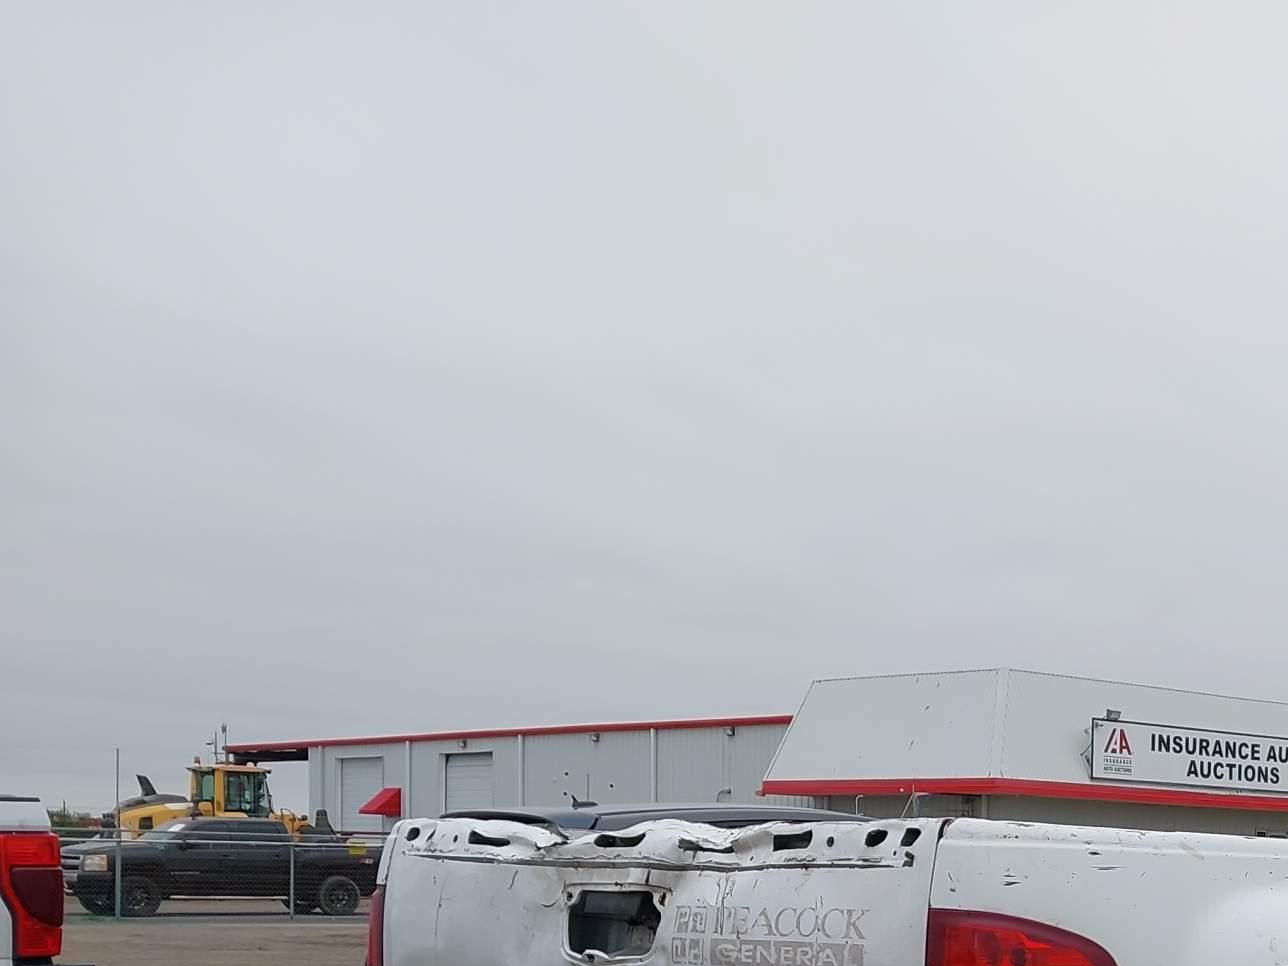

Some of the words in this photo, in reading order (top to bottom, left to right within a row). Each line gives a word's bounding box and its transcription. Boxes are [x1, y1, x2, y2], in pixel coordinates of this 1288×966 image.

[1151, 733, 1261, 761] INSURANCE
[1186, 759, 1280, 784] AUCTIONS
[713, 905, 869, 940] PEACOCK
